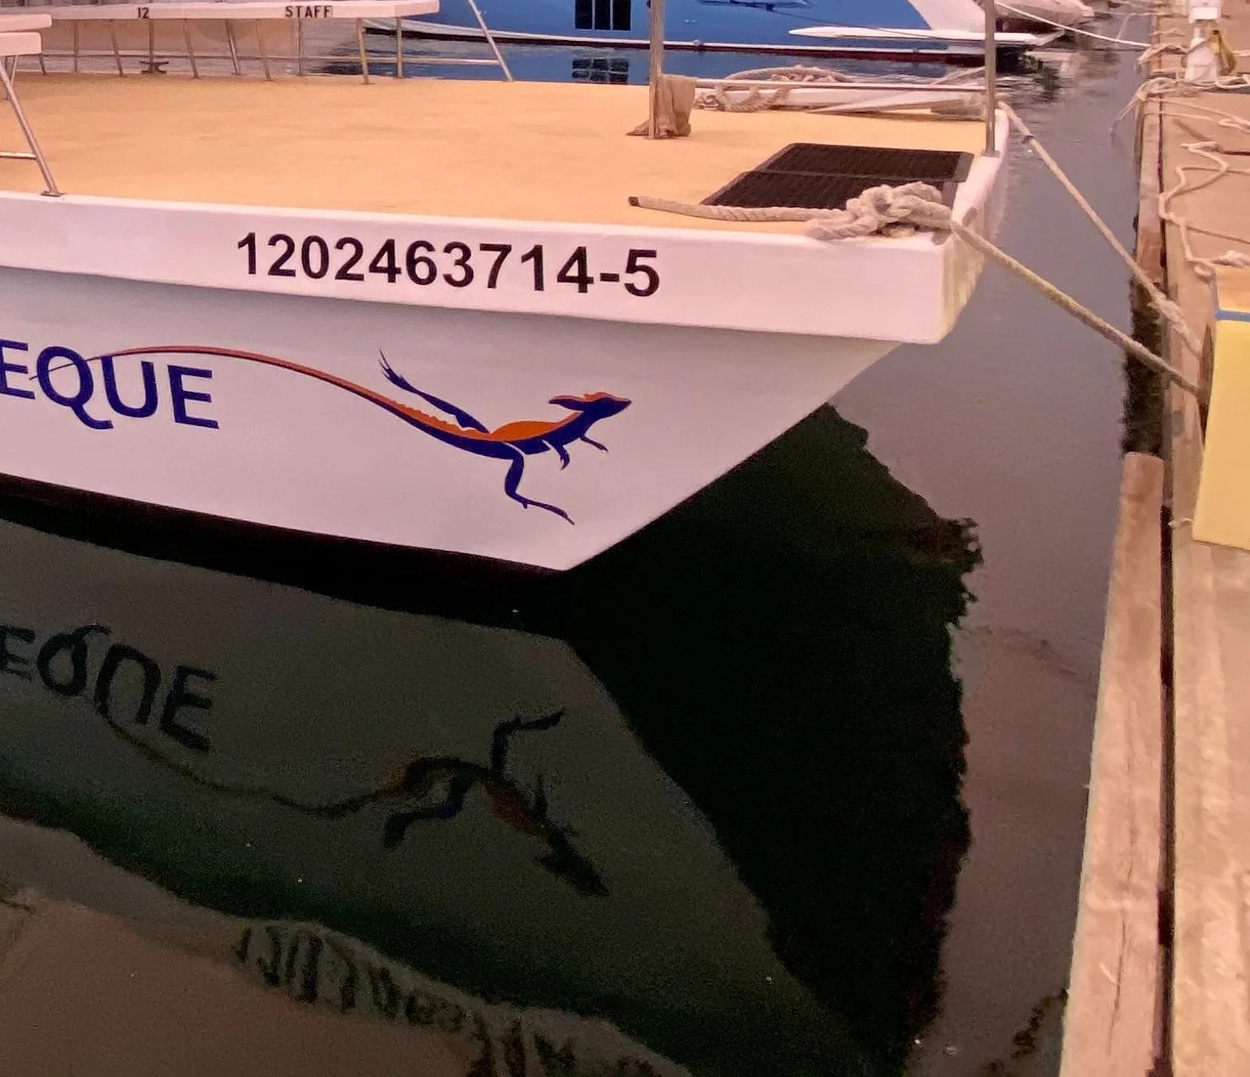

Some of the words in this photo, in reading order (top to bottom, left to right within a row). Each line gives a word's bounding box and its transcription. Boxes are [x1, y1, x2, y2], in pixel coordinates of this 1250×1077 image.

[137, 6, 150, 19] 12
[285, 4, 333, 19] STAFF
[237, 232, 661, 298] 1202463714-5
